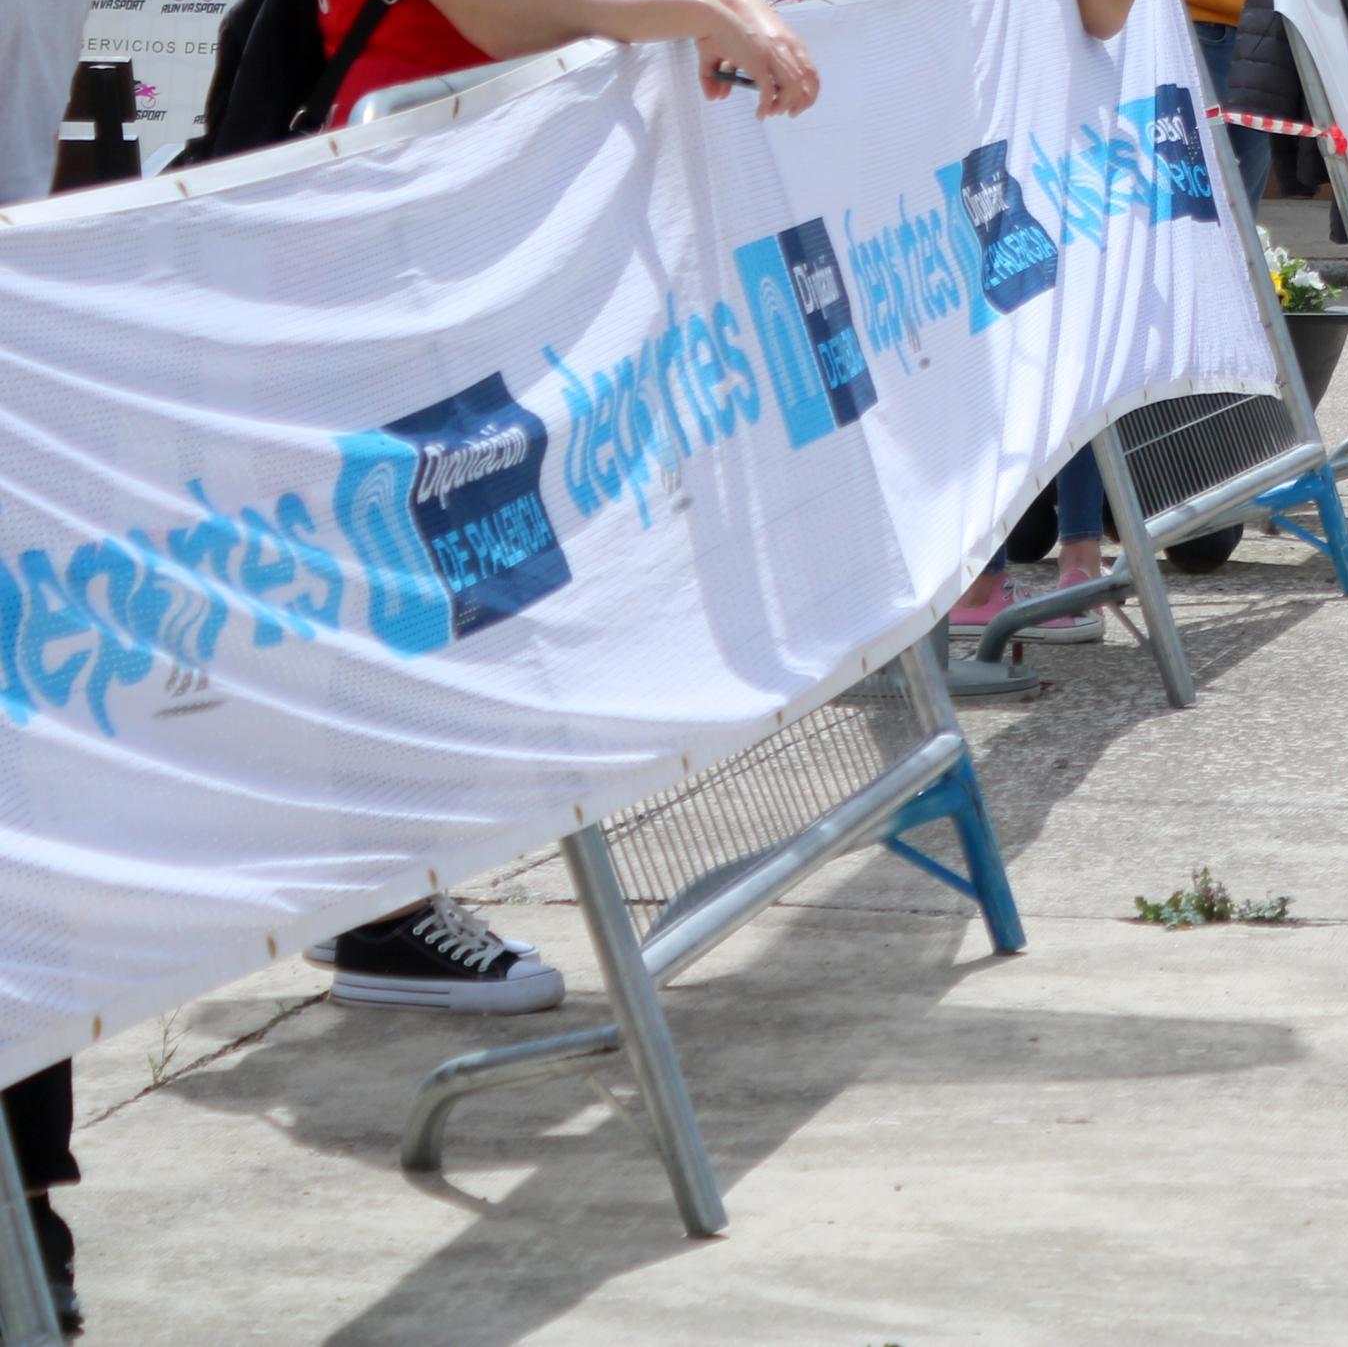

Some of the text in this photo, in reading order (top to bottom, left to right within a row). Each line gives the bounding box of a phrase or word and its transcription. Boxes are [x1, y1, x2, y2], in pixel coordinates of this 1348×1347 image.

[543, 290, 760, 529] deportes
[417, 425, 526, 510] Diputación
[431, 490, 549, 591] DE PALENCIA
